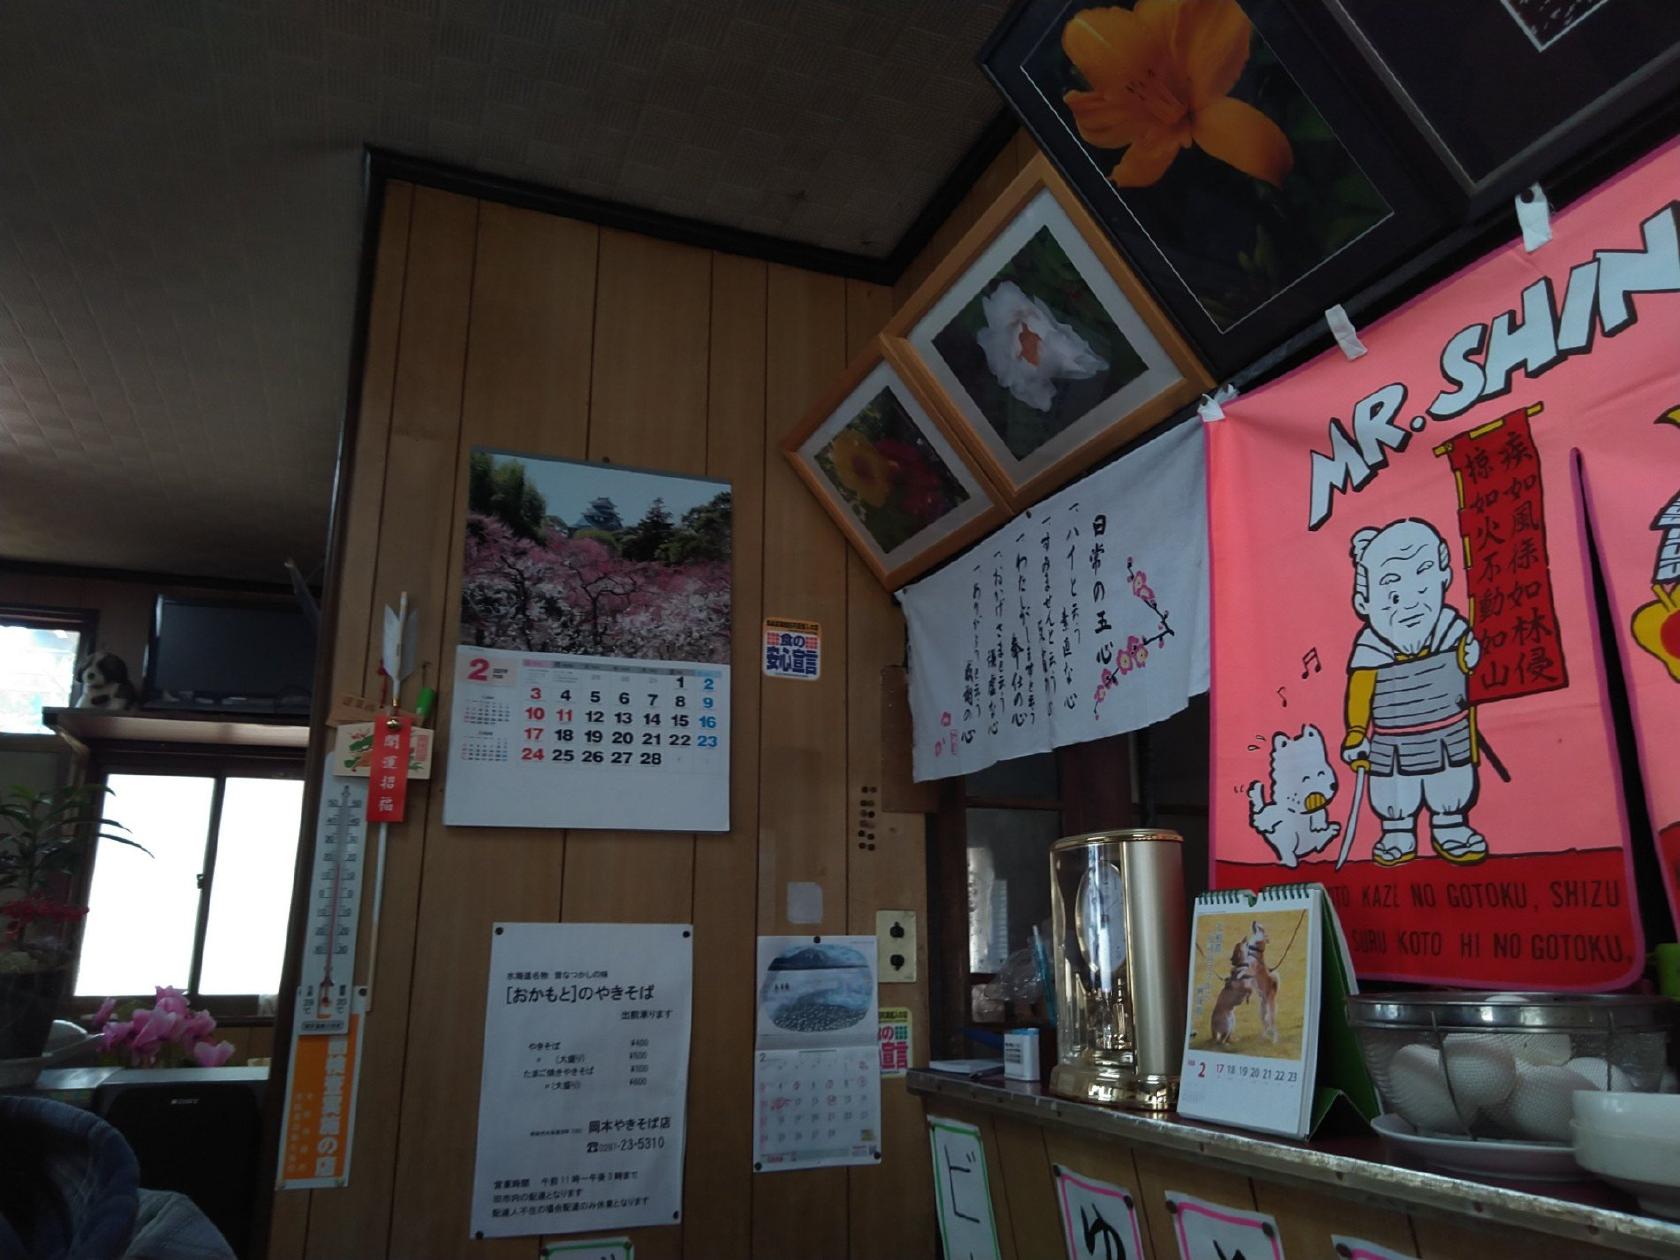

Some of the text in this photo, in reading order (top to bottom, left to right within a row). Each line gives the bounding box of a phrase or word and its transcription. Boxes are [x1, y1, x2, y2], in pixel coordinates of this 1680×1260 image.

[467, 658, 490, 681] 2
[677, 677, 713, 689] 1 2
[531, 688, 713, 708] 3 4 5 6 7 8 9
[526, 707, 716, 728] 10 11 12 13 14 15 16
[525, 728, 717, 747] 17 18 19 20 21 22 23
[522, 748, 661, 765] 24 25 26 27 28
[1411, 883, 1436, 908] NO
[1550, 880, 1620, 909] SHIZU
[1399, 930, 1442, 957] KOTO
[1460, 933, 1481, 957] HI
[1493, 932, 1521, 959] NO
[506, 984, 655, 1005] [おかもと]のやきそば
